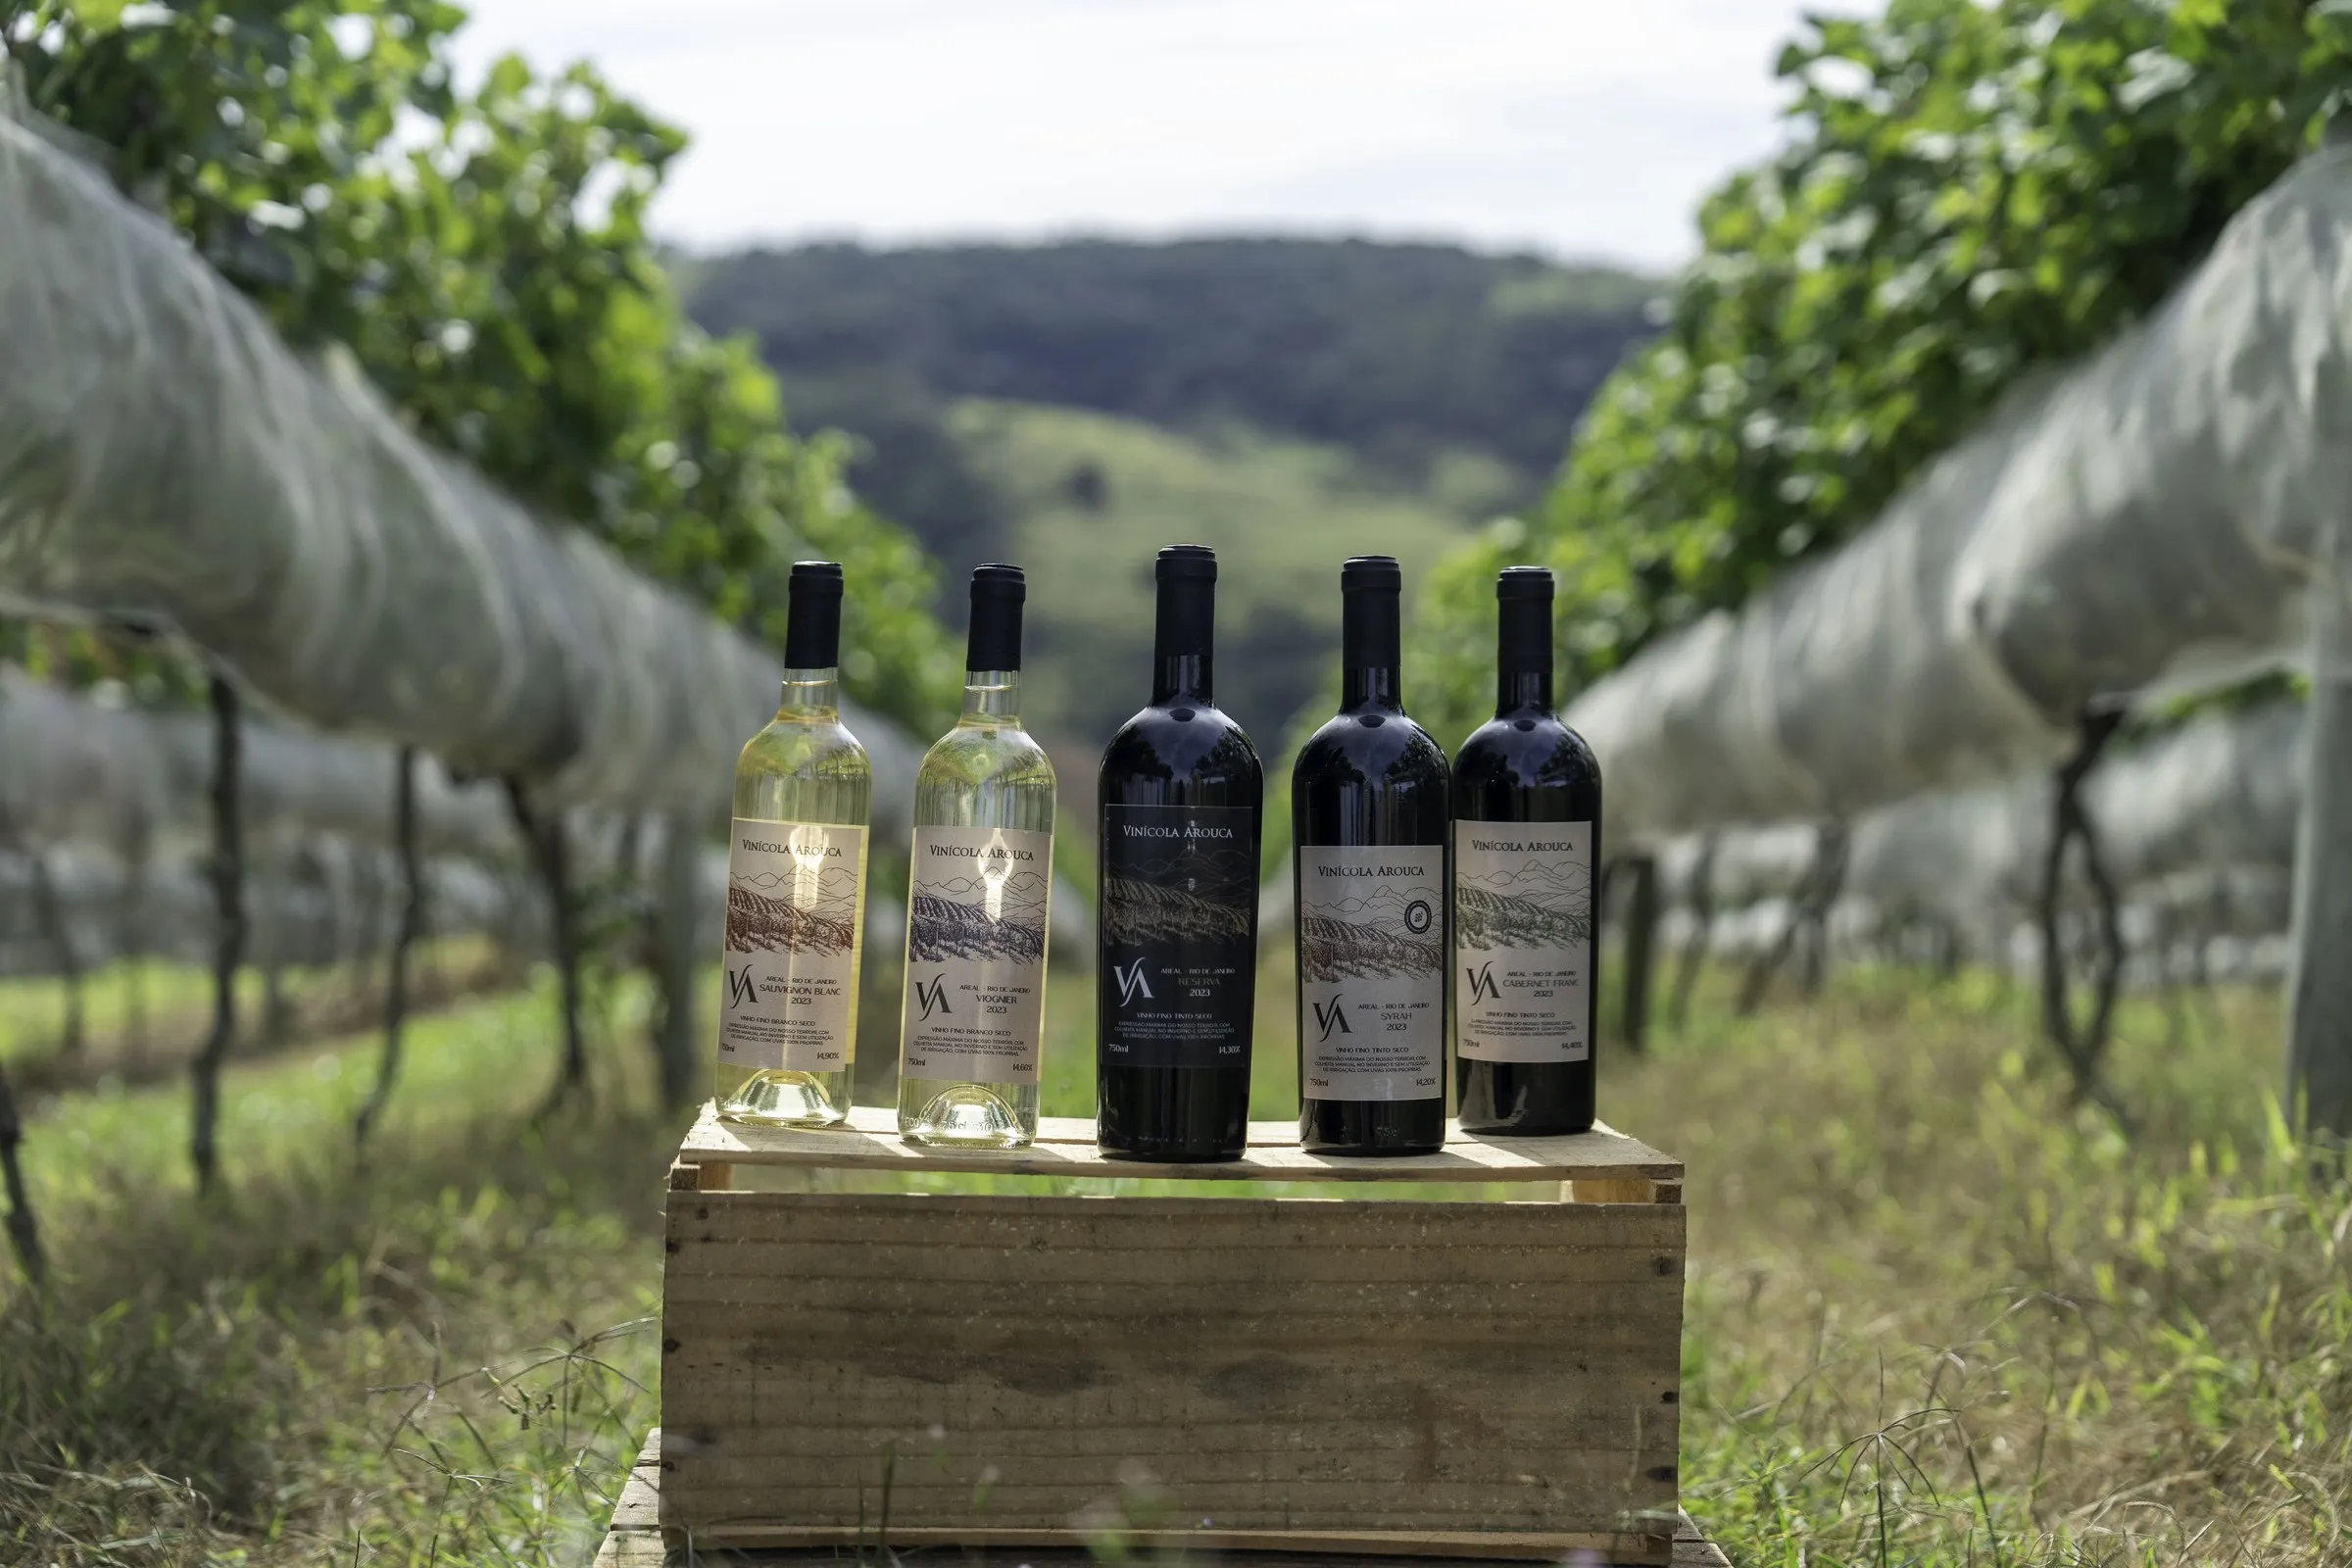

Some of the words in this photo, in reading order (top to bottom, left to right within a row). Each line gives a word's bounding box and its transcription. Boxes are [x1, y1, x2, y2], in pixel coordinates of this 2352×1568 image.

[1502, 979, 1550, 988] CABERNET
[760, 984, 812, 995] SAUVIGNON
[976, 995, 1017, 1004] VIOGNIER
[1108, 1044, 1128, 1053] 750ml
